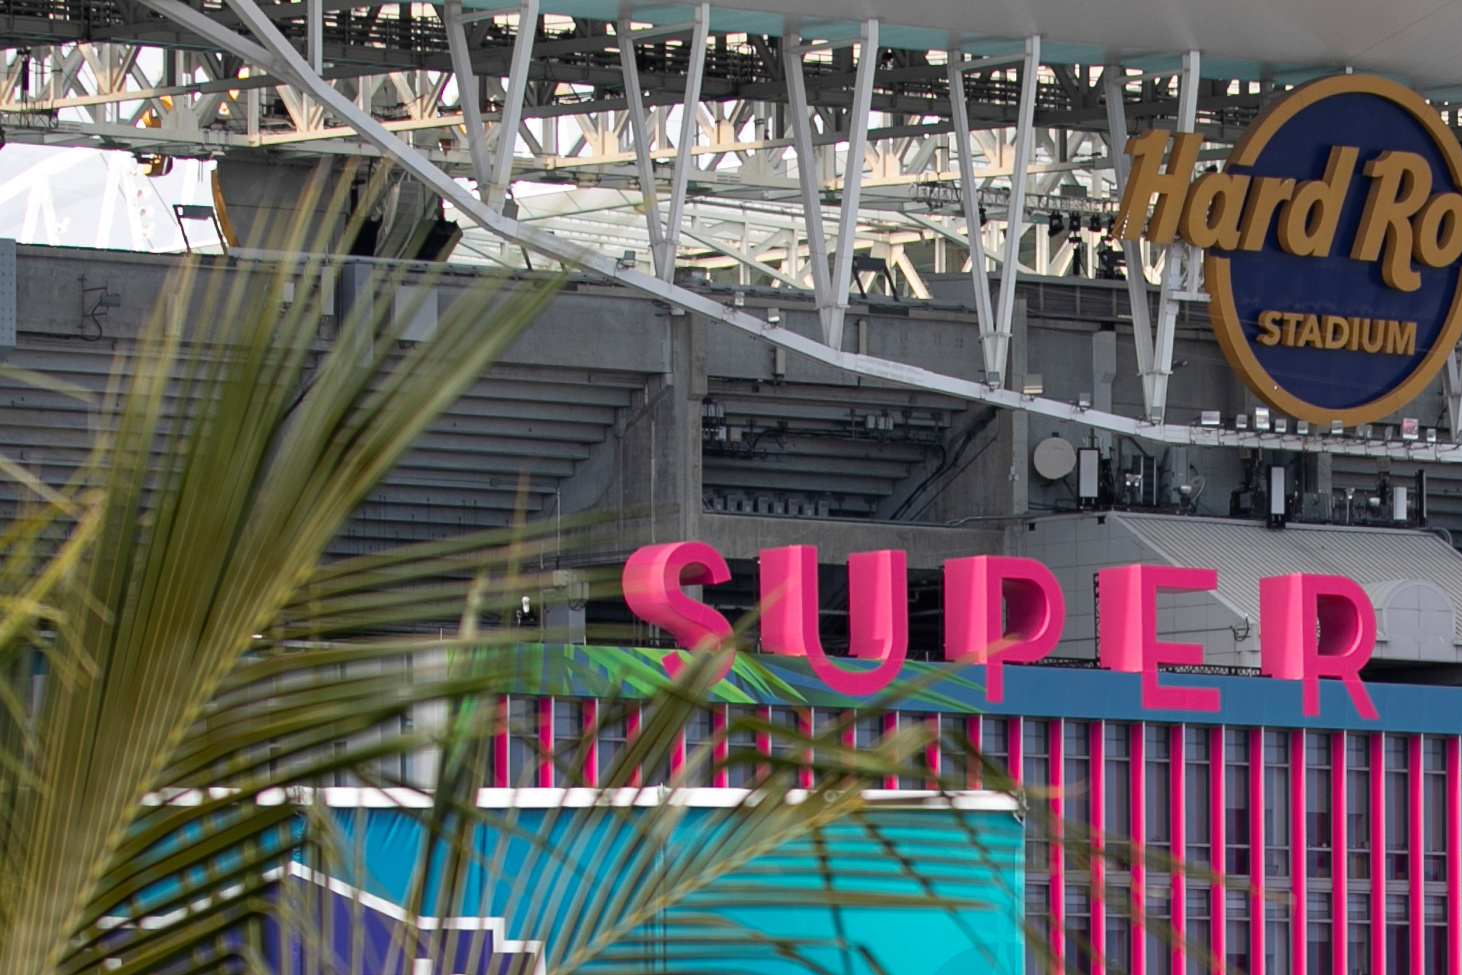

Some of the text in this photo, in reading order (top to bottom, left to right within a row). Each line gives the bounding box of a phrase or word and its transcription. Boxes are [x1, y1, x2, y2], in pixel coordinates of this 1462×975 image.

[1113, 129, 1360, 258] Hard
[1257, 310, 1418, 356] STADIUM
[622, 540, 1380, 720] SUPER
